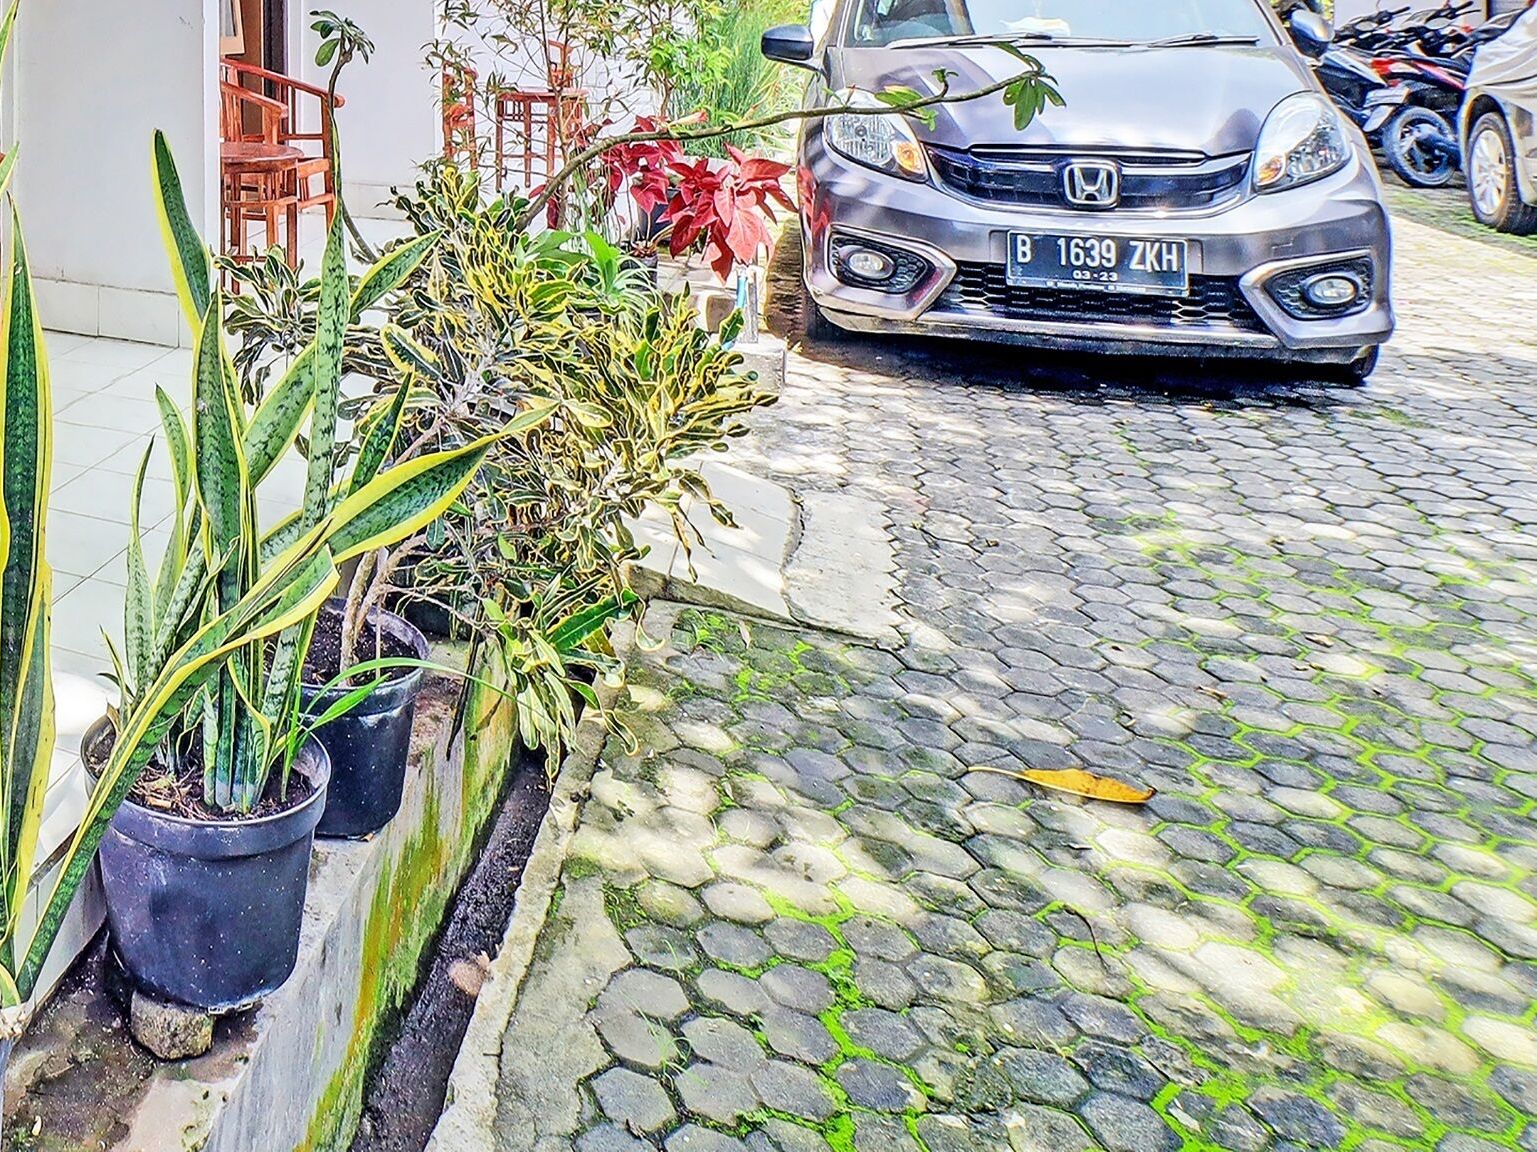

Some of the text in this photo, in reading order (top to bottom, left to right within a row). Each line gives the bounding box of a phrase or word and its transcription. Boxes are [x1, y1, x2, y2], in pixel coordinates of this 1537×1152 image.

[1016, 234, 1179, 272] B 1639 ZKH
